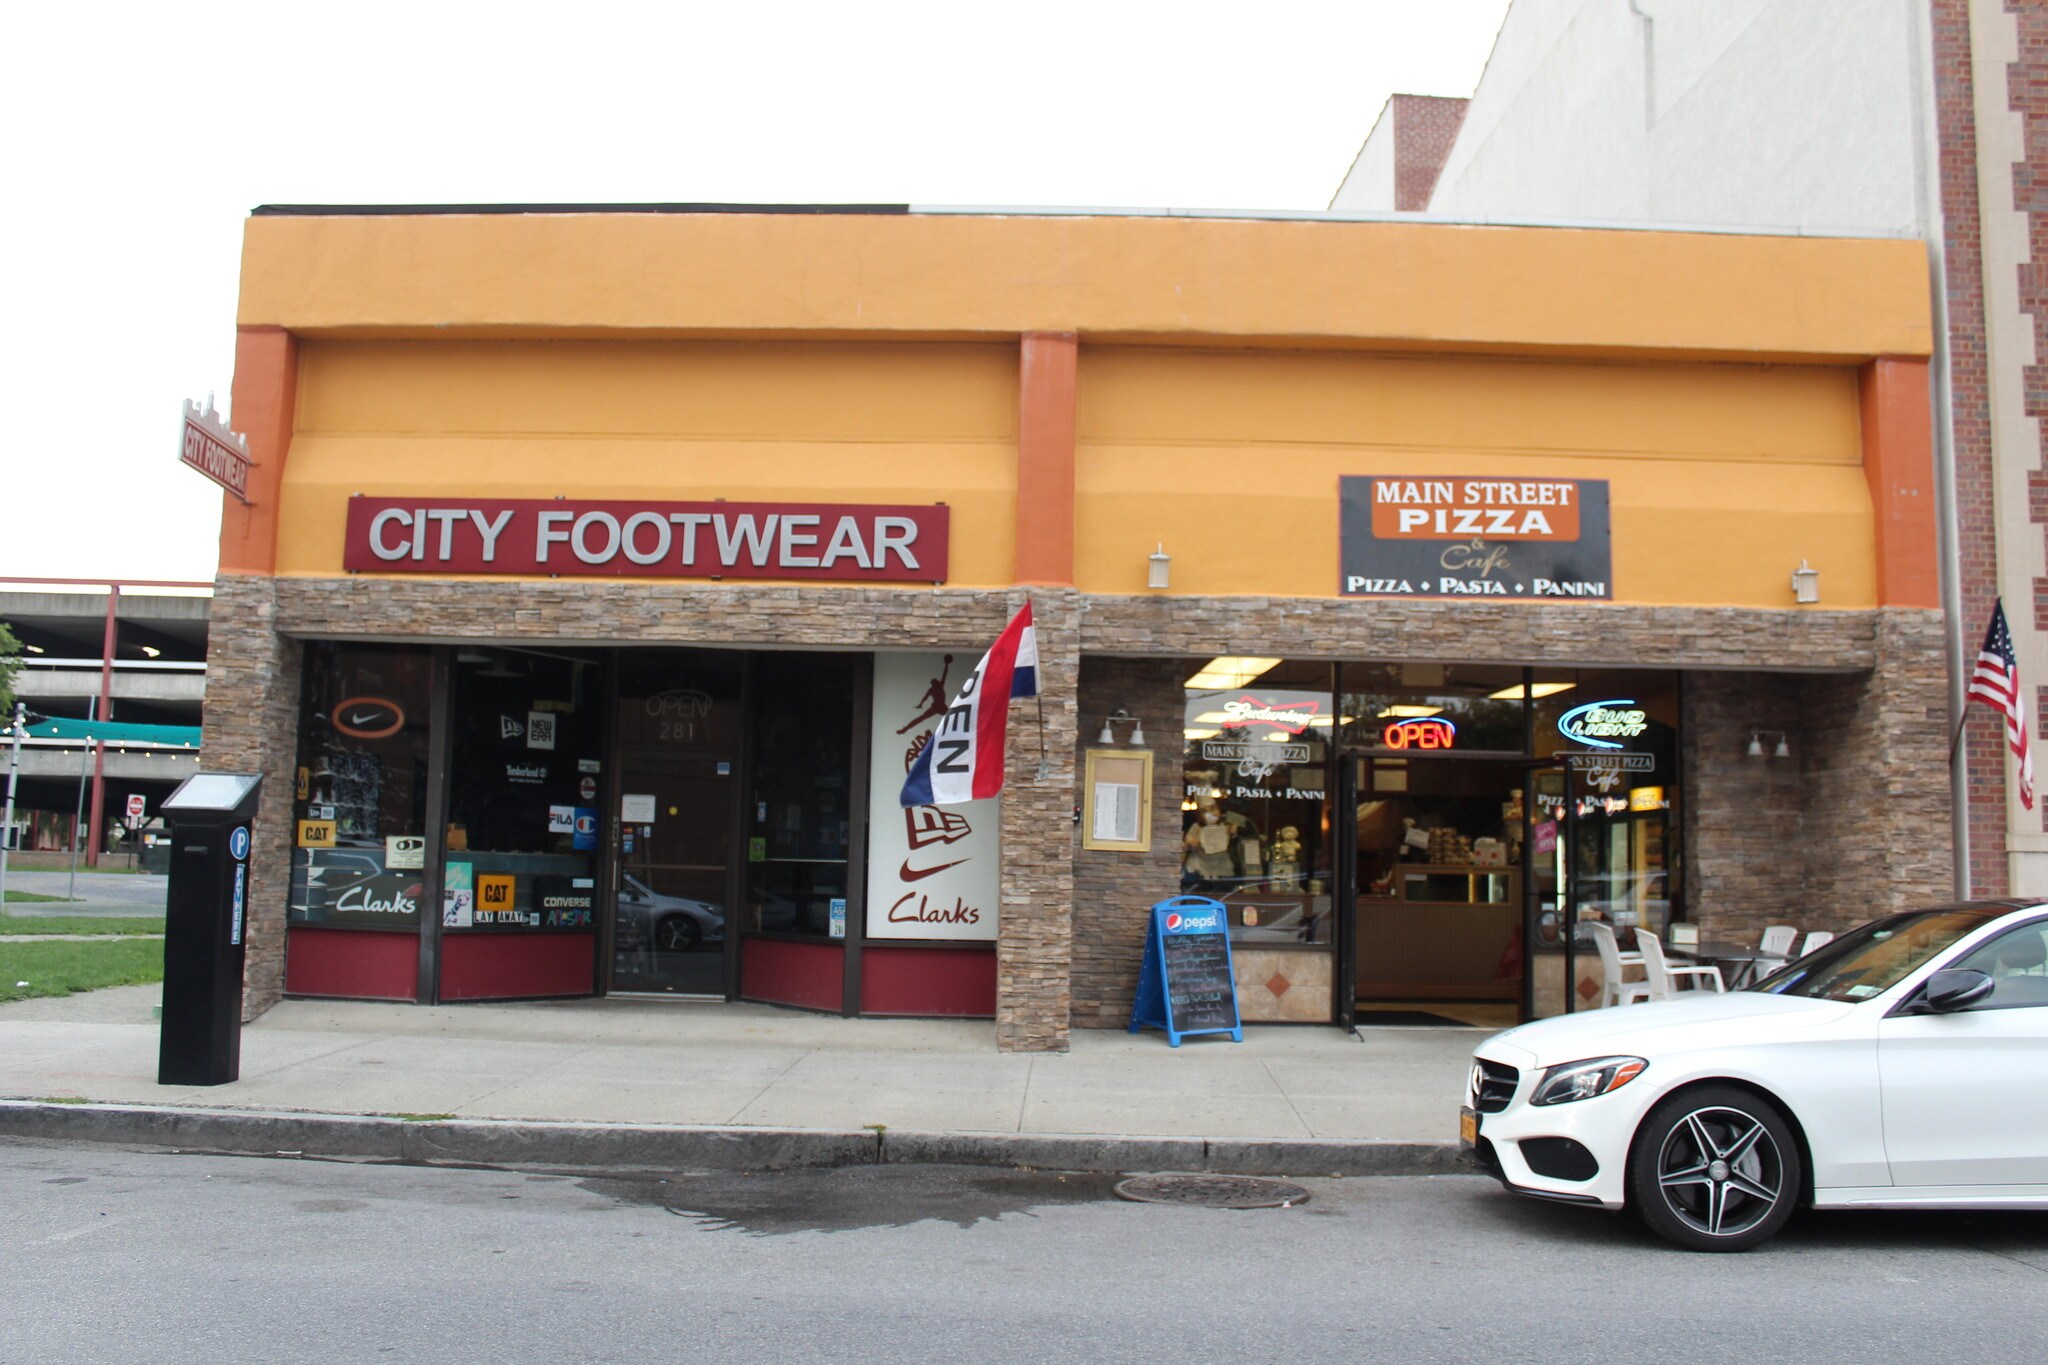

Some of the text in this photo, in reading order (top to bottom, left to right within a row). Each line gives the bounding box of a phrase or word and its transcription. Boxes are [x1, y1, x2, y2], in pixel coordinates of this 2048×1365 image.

[184, 426, 247, 491] CITY FOOTWEAR
[1376, 481, 1573, 506] MAIN STREET
[1398, 508, 1553, 535] PIZZA
[368, 508, 920, 569] CITY FOOTWEAR
[1470, 537, 1486, 550] &
[1347, 576, 1605, 596] PIZZA PASTA PANINI
[646, 695, 709, 717] OPEN
[531, 719, 552, 730] NEW
[659, 722, 693, 739] 281
[937, 670, 980, 775] PEN
[530, 731, 552, 742] ERA
[1384, 723, 1452, 750] OPEN
[1206, 745, 1234, 758] MAIN
[1585, 756, 1619, 768] STREET
[1623, 756, 1651, 768] PIZZA
[1187, 785, 1326, 800] PIZZ PASTA PANINI
[549, 813, 573, 825] FILA
[305, 827, 328, 840] CAT
[236, 833, 246, 854] P
[336, 886, 416, 914] Clarks
[484, 884, 509, 903] CAT
[544, 897, 591, 907] CONVERSE
[474, 912, 493, 922] LAY
[498, 912, 523, 922] AWAY
[887, 891, 980, 925] Clarks
[1184, 915, 1217, 930] pepsi
